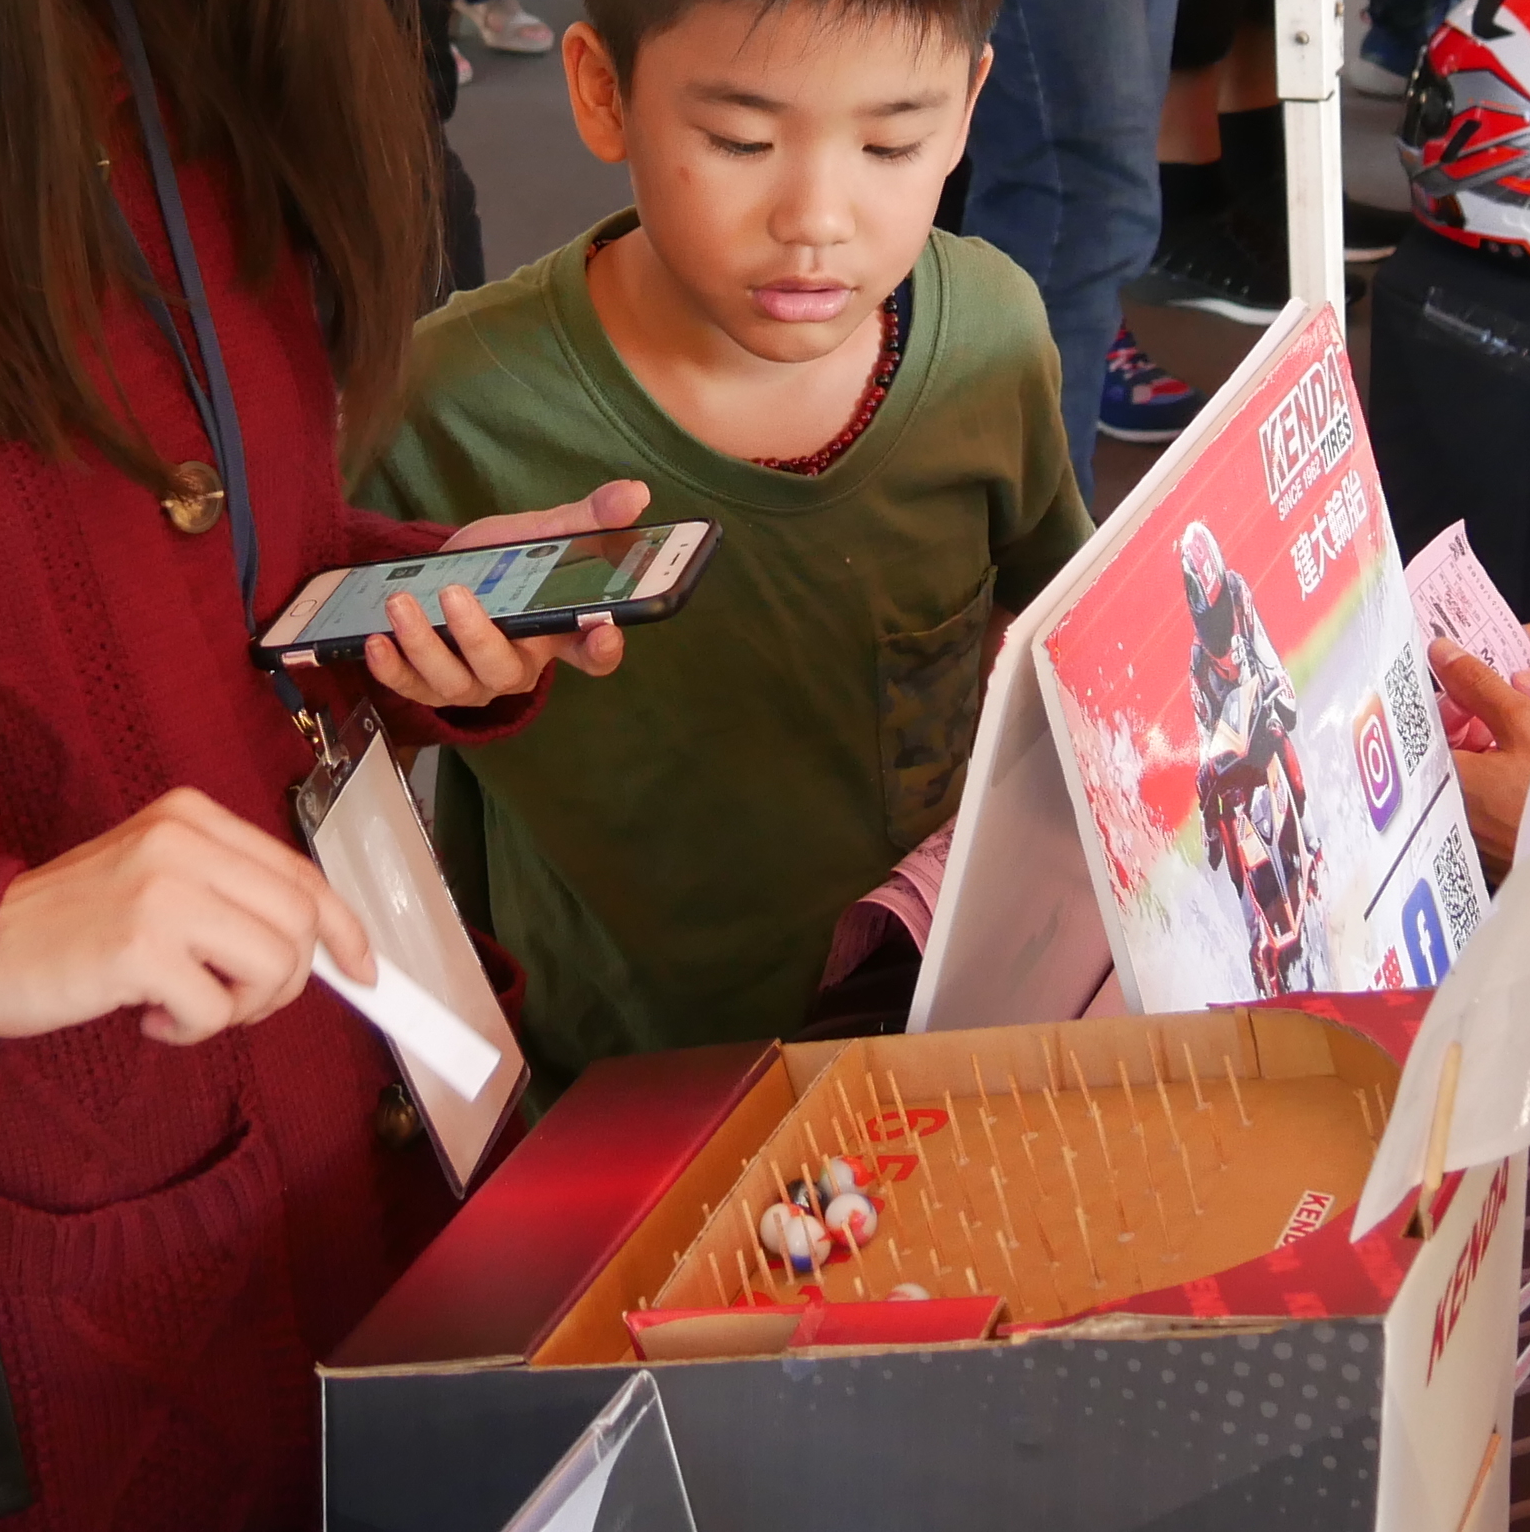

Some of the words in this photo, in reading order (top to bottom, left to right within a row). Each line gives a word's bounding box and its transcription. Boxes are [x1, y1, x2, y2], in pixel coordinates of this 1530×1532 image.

[1258, 343, 1348, 505] KENDA
[1319, 410, 1353, 470] TIRES
[1277, 476, 1305, 521] SINCE
[1301, 454, 1321, 491] 1962
[1290, 468, 1367, 601] 建大輪胎
[1279, 1191, 1331, 1248] KEN
[1425, 1154, 1510, 1387] KENDA
